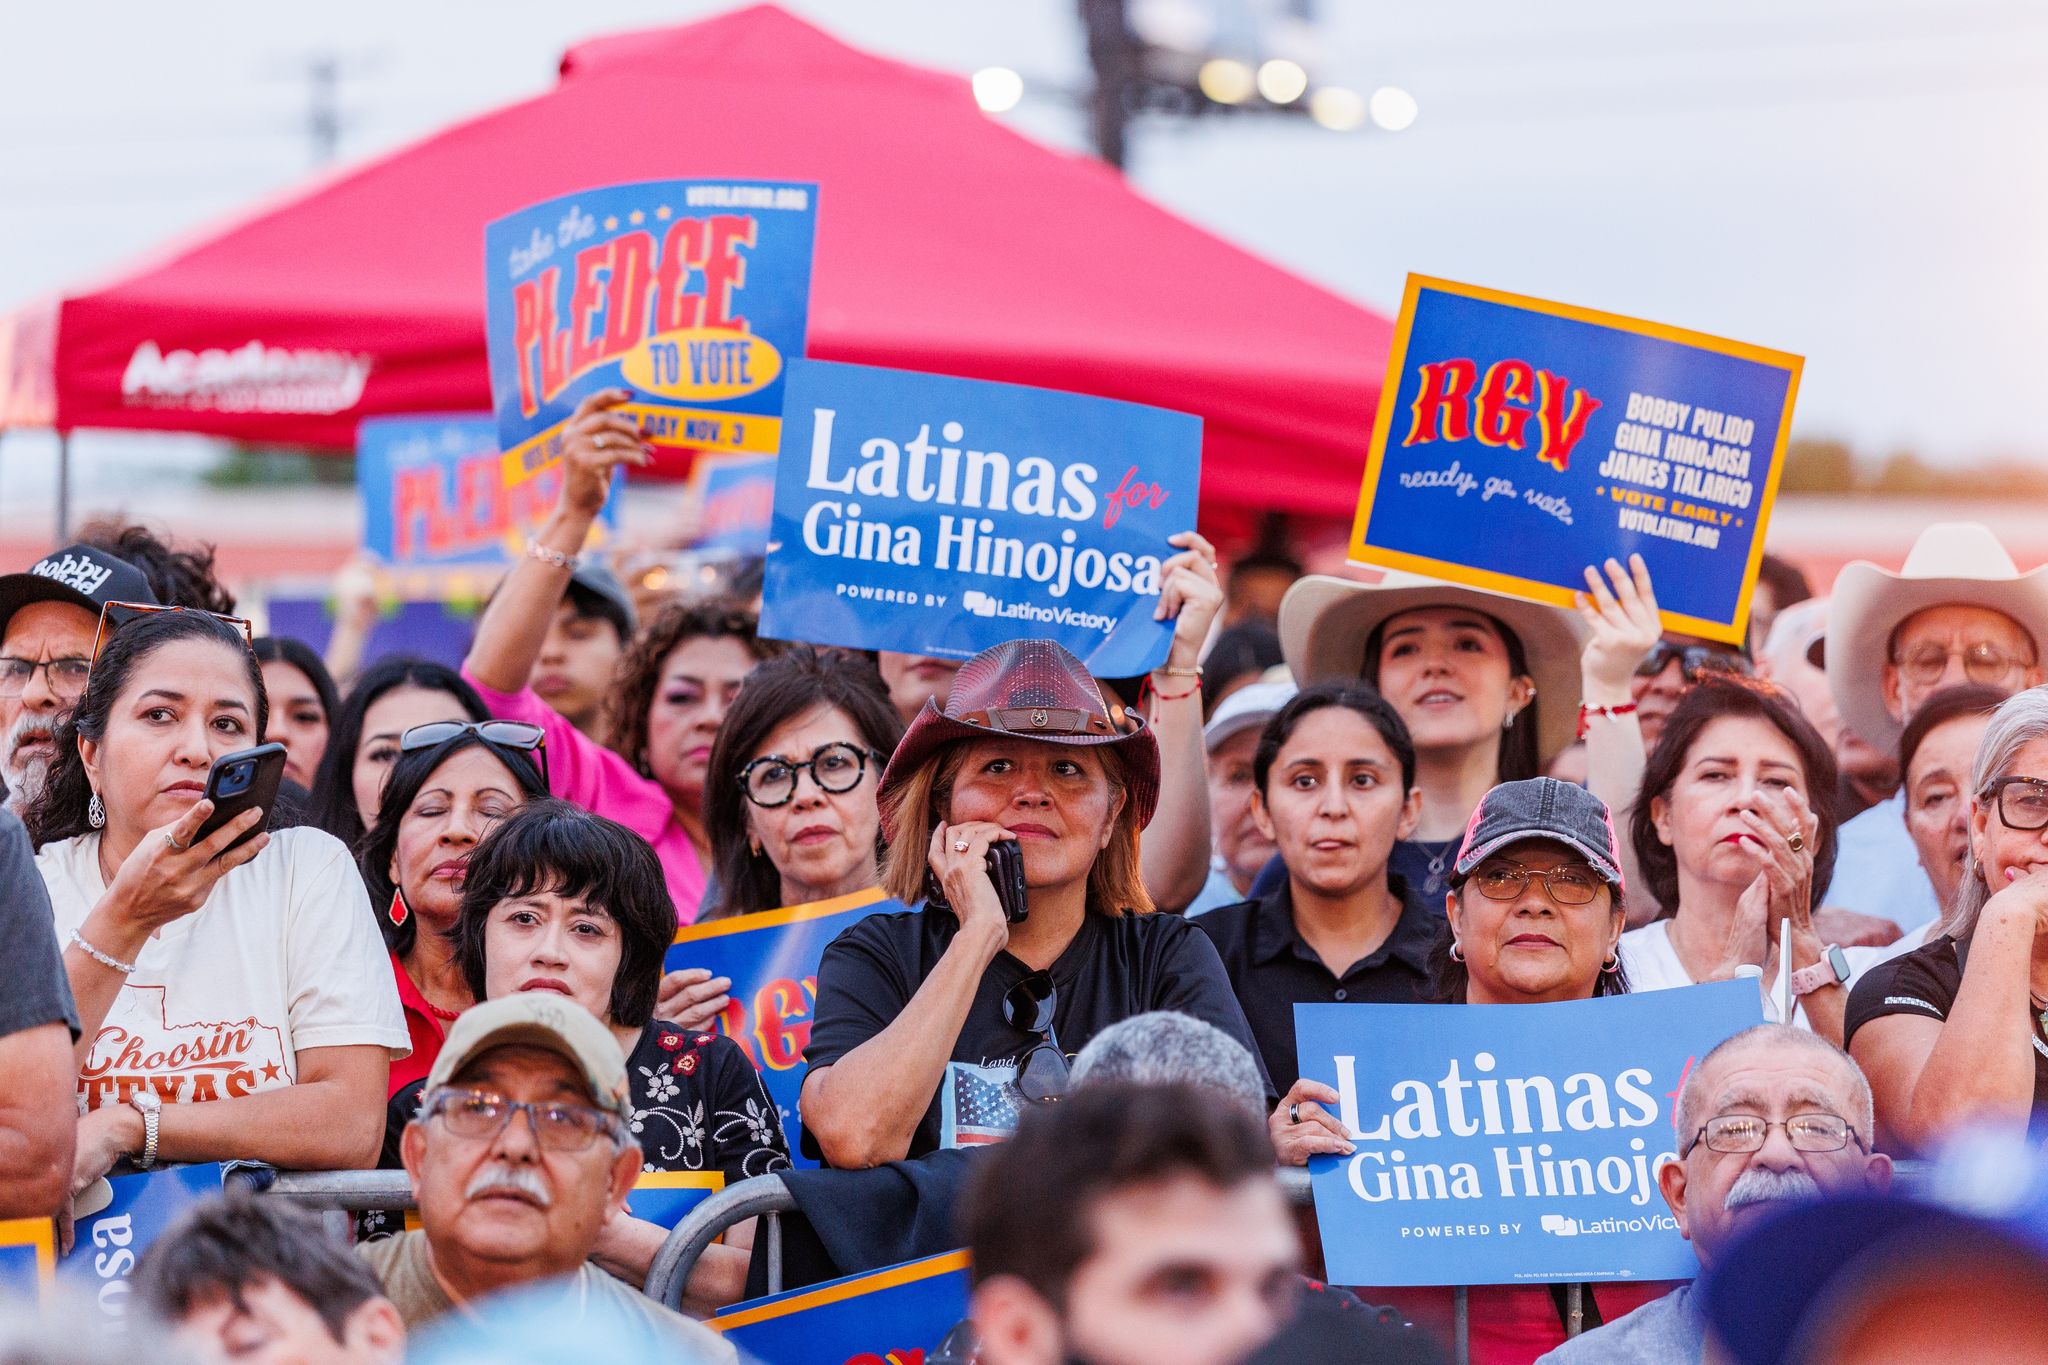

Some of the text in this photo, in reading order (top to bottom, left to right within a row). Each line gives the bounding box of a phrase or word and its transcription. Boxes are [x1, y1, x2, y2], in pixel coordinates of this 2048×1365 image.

[513, 214, 758, 420] PLEDGE
[650, 341, 754, 386] TO VOTE
[644, 414, 679, 438] DAY
[732, 423, 745, 445] 3
[1402, 358, 1602, 473] RGV
[1625, 392, 1755, 448] BOBBY PULIDO
[806, 408, 1098, 521] Latinas
[1103, 465, 1170, 530] for
[1615, 422, 1751, 479] GINA HINOJOSA
[1599, 450, 1753, 510] JAMES TALARICO
[1610, 487, 1733, 527] VOTE EARLY
[802, 500, 921, 567] Gina
[934, 514, 1162, 598] Hinojosa
[836, 583, 1117, 634] POWERED BY LatinoVictory
[79, 1016, 258, 1077] Choosin'
[979, 1056, 1017, 1069] Land
[1333, 1052, 1659, 1141] Latinas
[1347, 1149, 1483, 1203] Gina
[1401, 1214, 1681, 1238] POWERED BY LatinoVict
